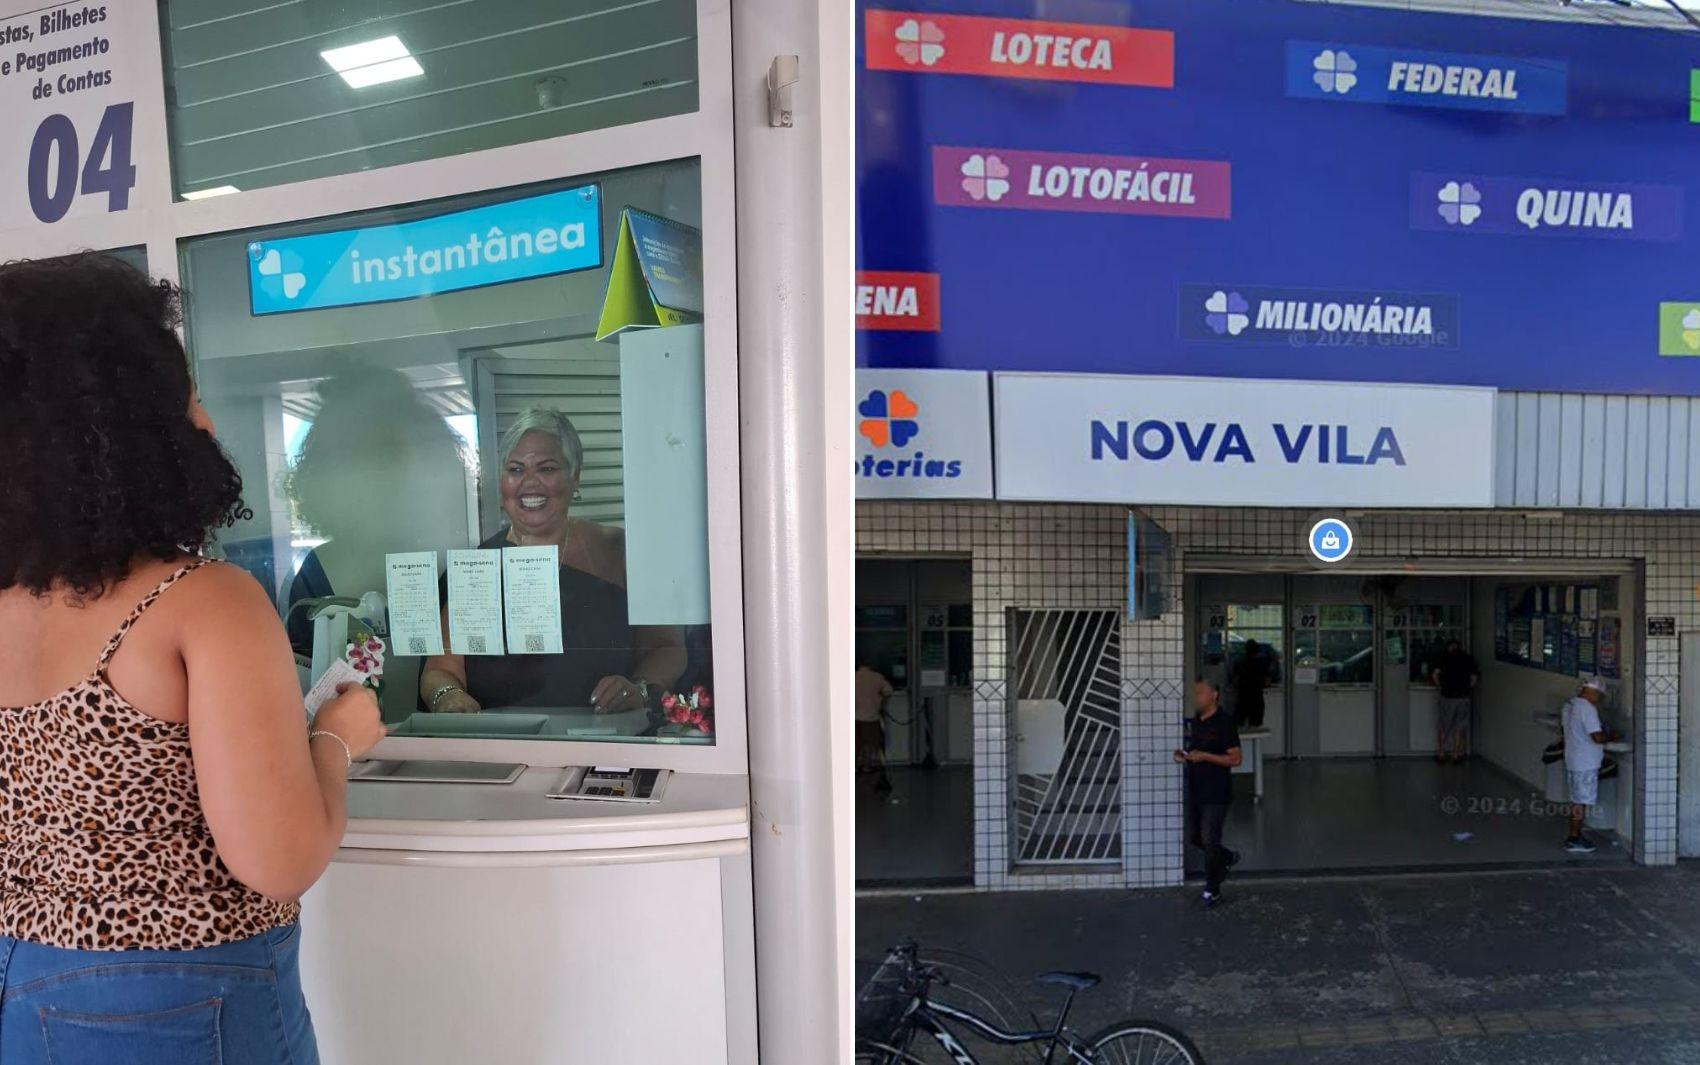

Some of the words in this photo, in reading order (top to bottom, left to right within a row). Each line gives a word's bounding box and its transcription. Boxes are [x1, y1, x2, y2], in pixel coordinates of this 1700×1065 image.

[40, 6, 107, 36] Bilhetes
[1, 61, 11, 76] e
[16, 36, 110, 73] Pagamento
[991, 32, 1112, 70] LOTECA
[32, 77, 52, 100] de
[57, 70, 112, 94] Contas
[1388, 62, 1518, 99] FEDERAL
[28, 101, 136, 224] 04
[1028, 163, 1195, 204] LOTOFÁCIL
[1516, 188, 1633, 229] QUINA
[350, 222, 585, 284] instantânea
[856, 286, 919, 316] ENA
[1255, 297, 1432, 335] MILIONÁRIA
[1091, 419, 1256, 464] NOVA
[1273, 424, 1406, 466] VILA
[855, 452, 961, 478] terias
[1209, 615, 1225, 628] 03
[1301, 615, 1316, 628] 02
